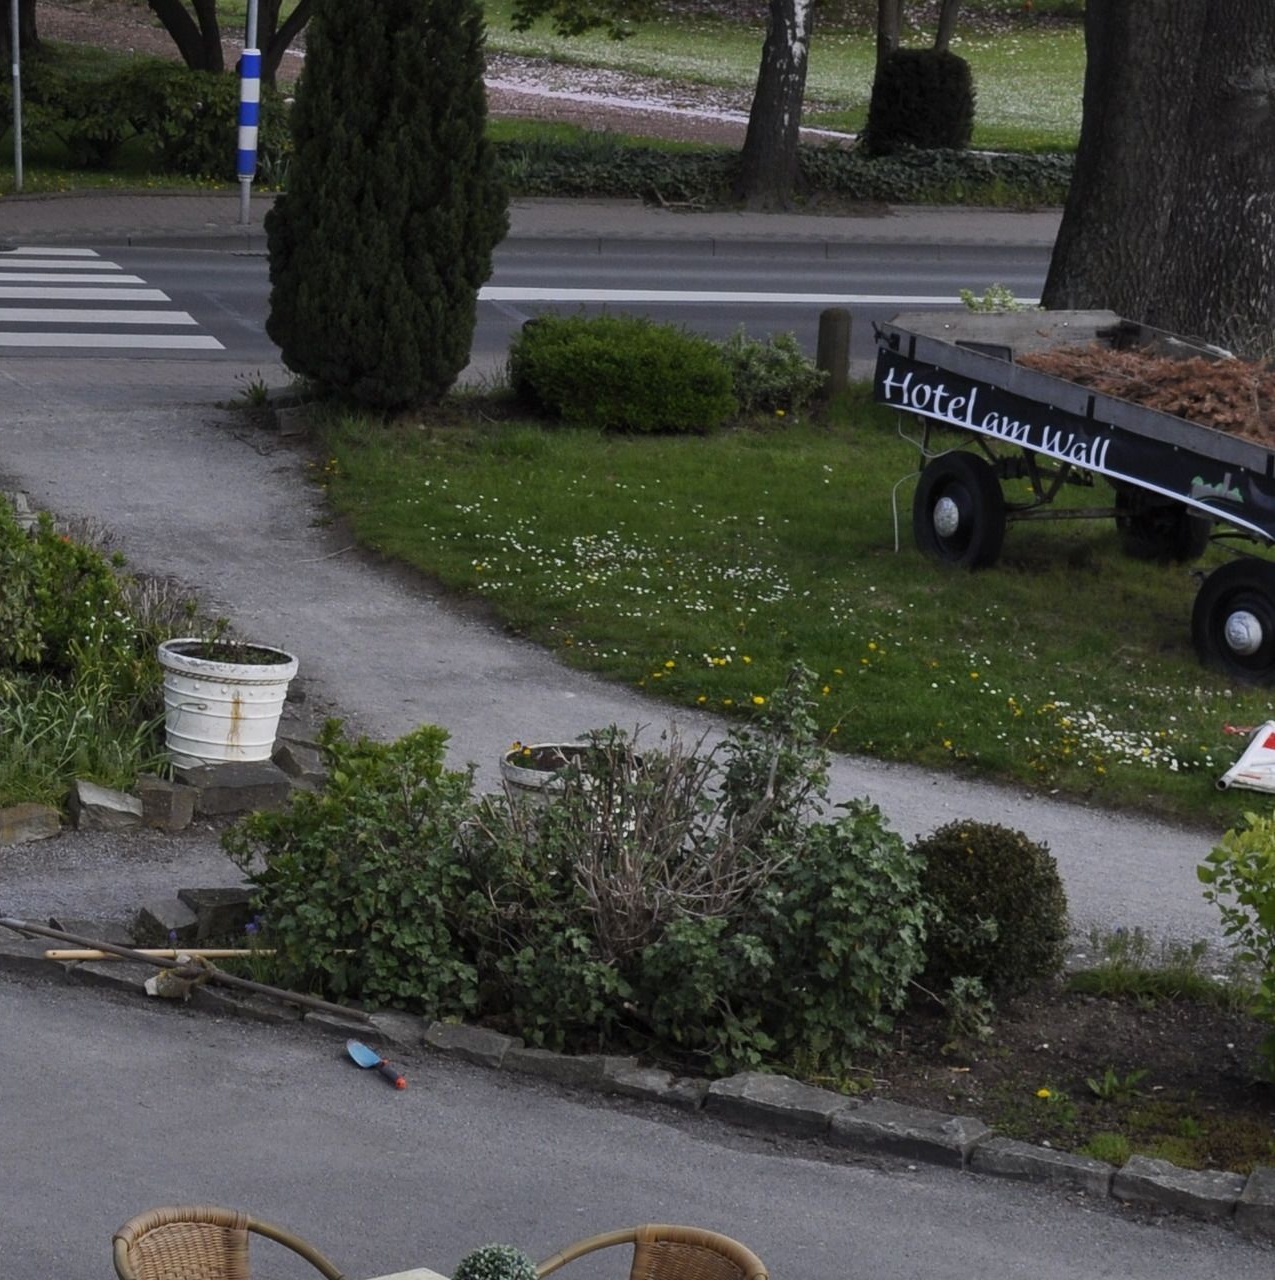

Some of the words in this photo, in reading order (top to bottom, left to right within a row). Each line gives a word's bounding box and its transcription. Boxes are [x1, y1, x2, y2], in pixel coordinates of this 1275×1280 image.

[883, 367, 978, 427] Hotel
[981, 411, 1031, 444] am
[1041, 425, 1111, 470] Wall
